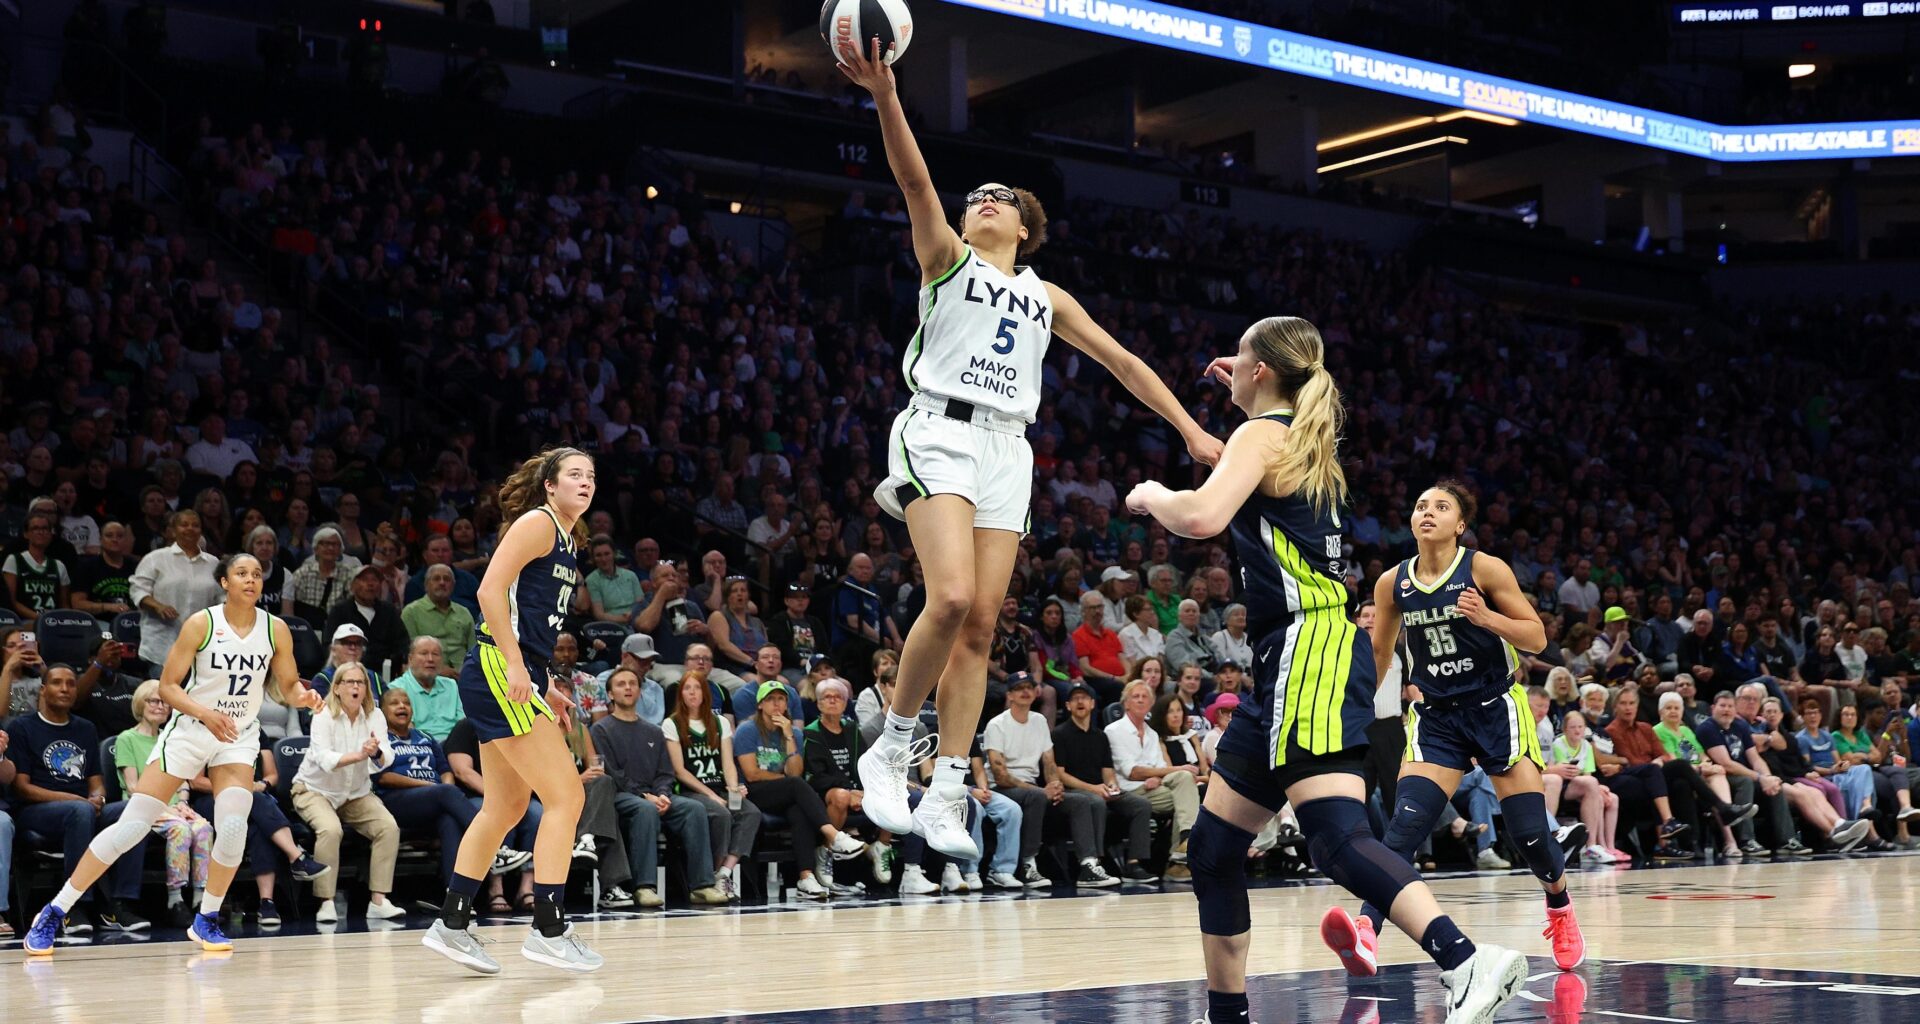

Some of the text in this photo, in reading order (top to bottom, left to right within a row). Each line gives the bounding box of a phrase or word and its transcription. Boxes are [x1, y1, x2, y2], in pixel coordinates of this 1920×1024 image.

[1824, 5, 1850, 16] IVER
[1049, 0, 1087, 19] THE
[1086, 0, 1223, 47] UNIMAGINABLE
[1267, 38, 1920, 153] CURING THE UNCURABLE SOLVING THE UNSOLVABLE TREATING THE UNTREATABLE PR
[836, 141, 868, 164] 112
[1193, 186, 1219, 205] 113
[964, 277, 1047, 330] LYNX
[990, 316, 1019, 355] 5
[969, 355, 1017, 381] MAYO
[960, 371, 1017, 399] CLINIC
[551, 563, 577, 585] DALL
[25, 582, 55, 594] LYNX
[1444, 582, 1466, 592] Albert
[32, 595, 55, 610] 24
[1402, 604, 1466, 627] DALLA
[1423, 624, 1458, 658] 35
[210, 652, 268, 671] LYNX
[1440, 657, 1475, 676] CVS
[228, 674, 252, 696] 12
[217, 699, 249, 709] MAYO
[406, 769, 436, 779] MAYO
[693, 757, 717, 778] 24
